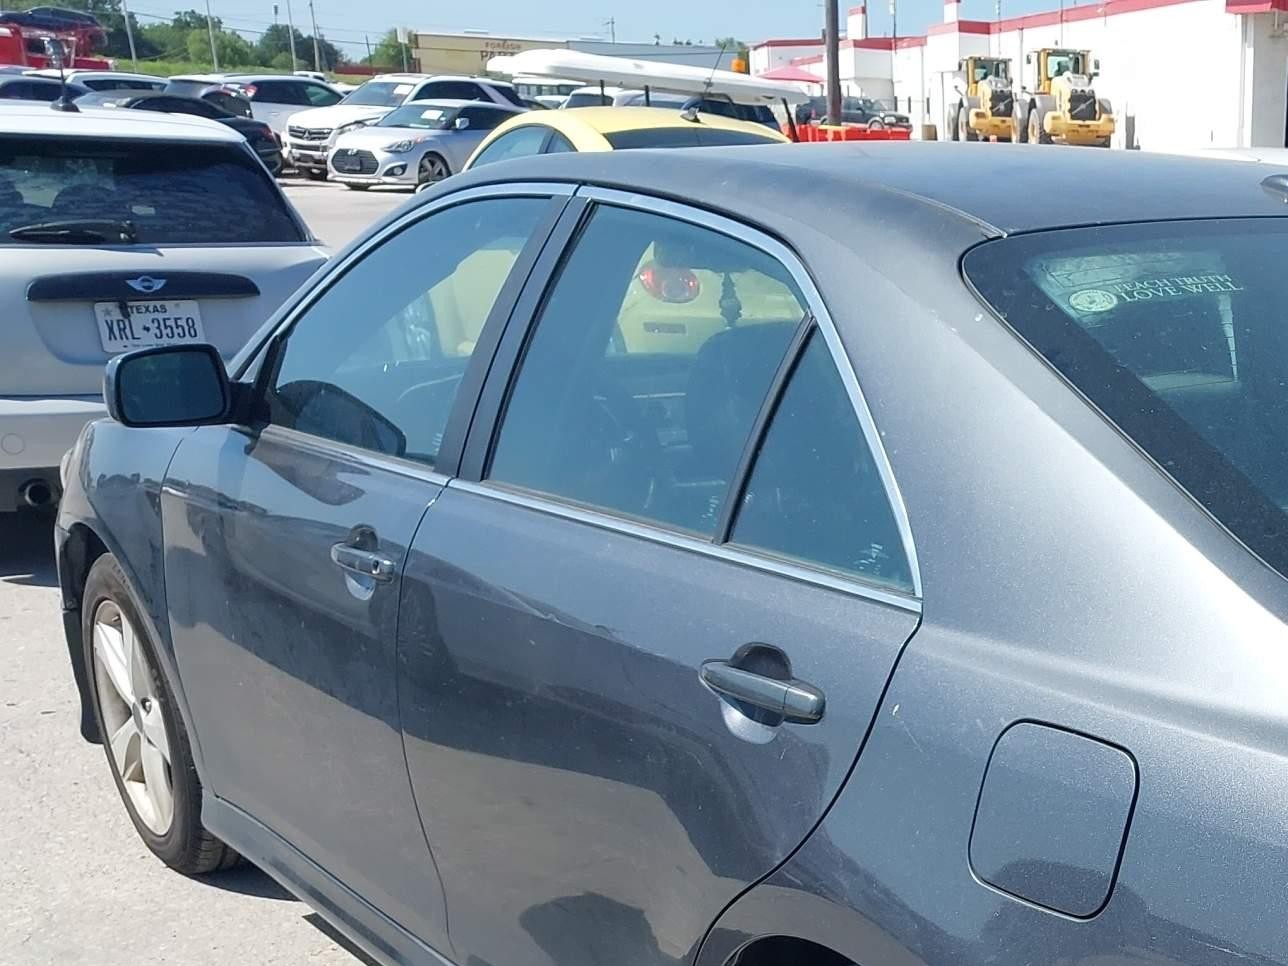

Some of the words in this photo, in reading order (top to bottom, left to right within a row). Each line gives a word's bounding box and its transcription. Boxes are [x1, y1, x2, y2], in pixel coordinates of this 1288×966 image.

[1113, 277, 1171, 293] TEACH
[1171, 273, 1233, 286] TRUTH
[1120, 286, 1182, 302] LOVE
[128, 304, 167, 314] TEXAS
